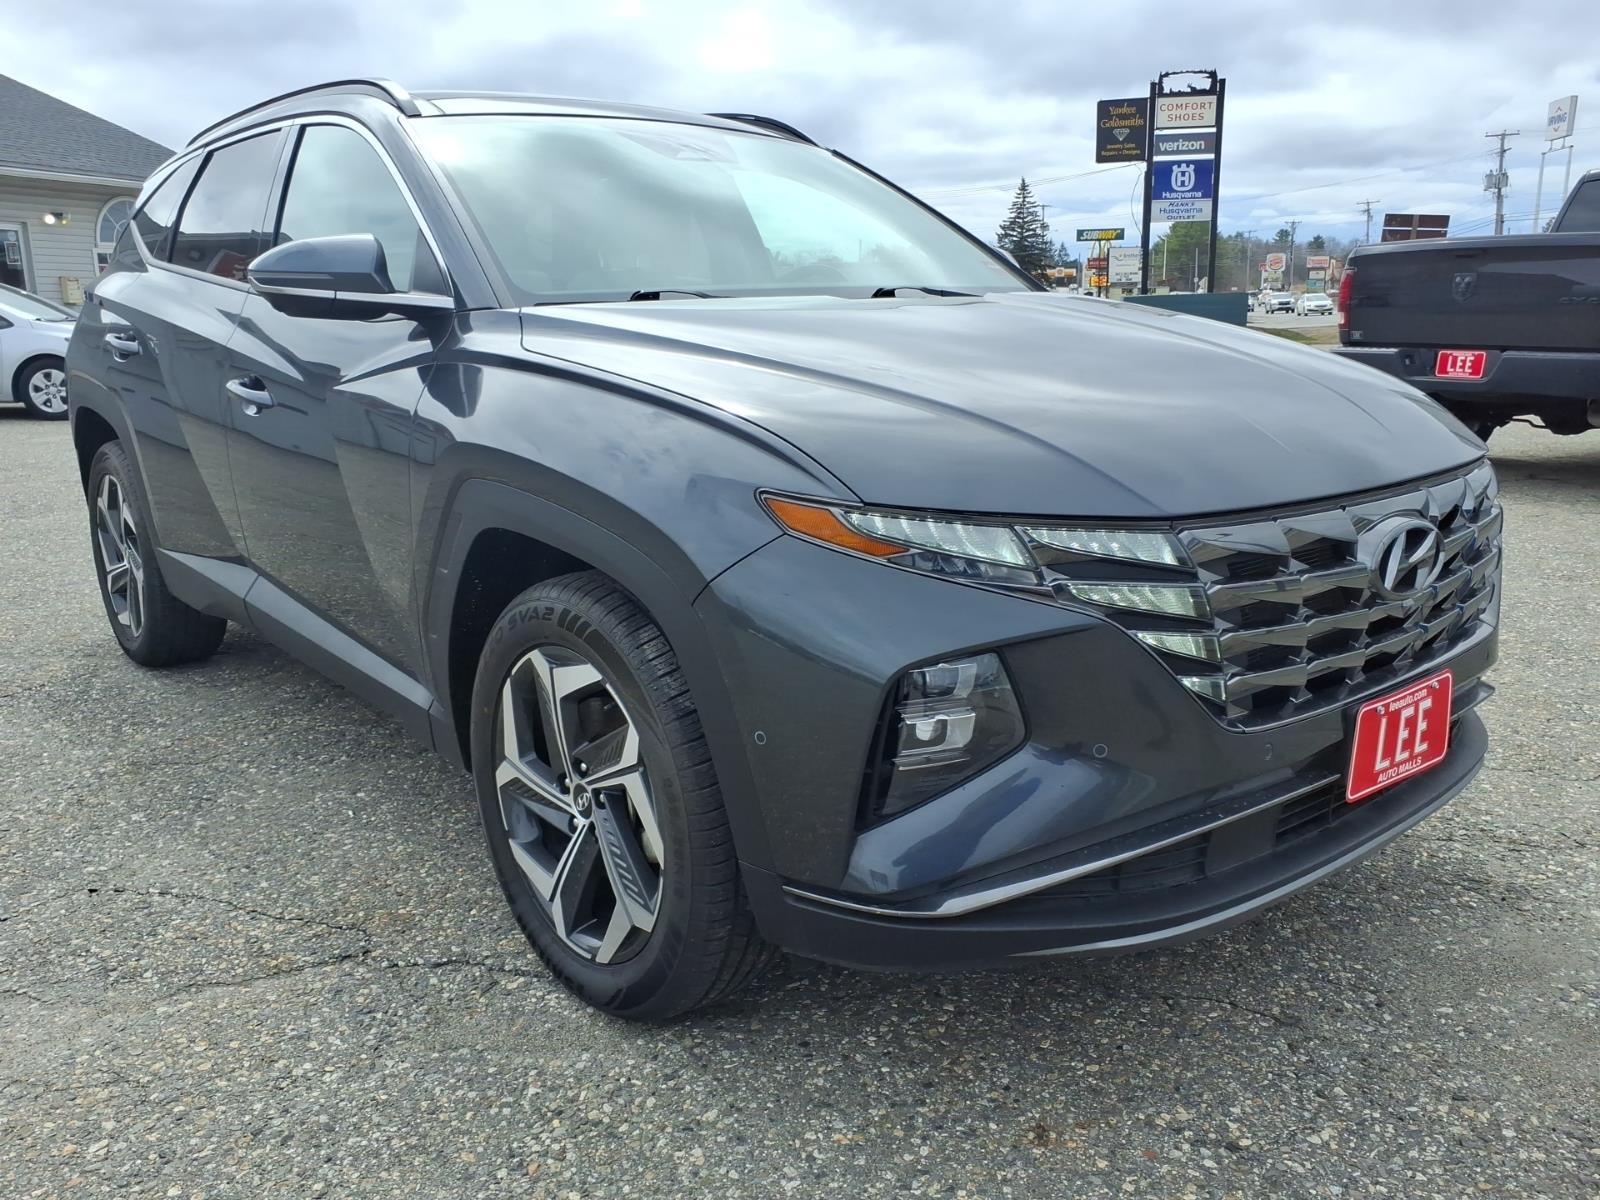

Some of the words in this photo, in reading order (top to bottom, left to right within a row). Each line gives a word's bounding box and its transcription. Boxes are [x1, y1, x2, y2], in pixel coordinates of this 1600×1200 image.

[1109, 102, 1137, 115] Yankee
[1159, 101, 1214, 112] COMFORT
[1100, 114, 1145, 128] Goldsmiths
[1167, 112, 1205, 122] SHOES
[1159, 139, 1205, 151] verizon
[1162, 191, 1203, 200] Husqvarna
[1159, 207, 1203, 215] Husqvarna
[1080, 229, 1121, 240] SUBWAY
[1446, 355, 1475, 373] LEE
[1374, 696, 1433, 772] LEE
[1377, 766, 1398, 783] AUTO
[1398, 756, 1422, 775] MALLS
